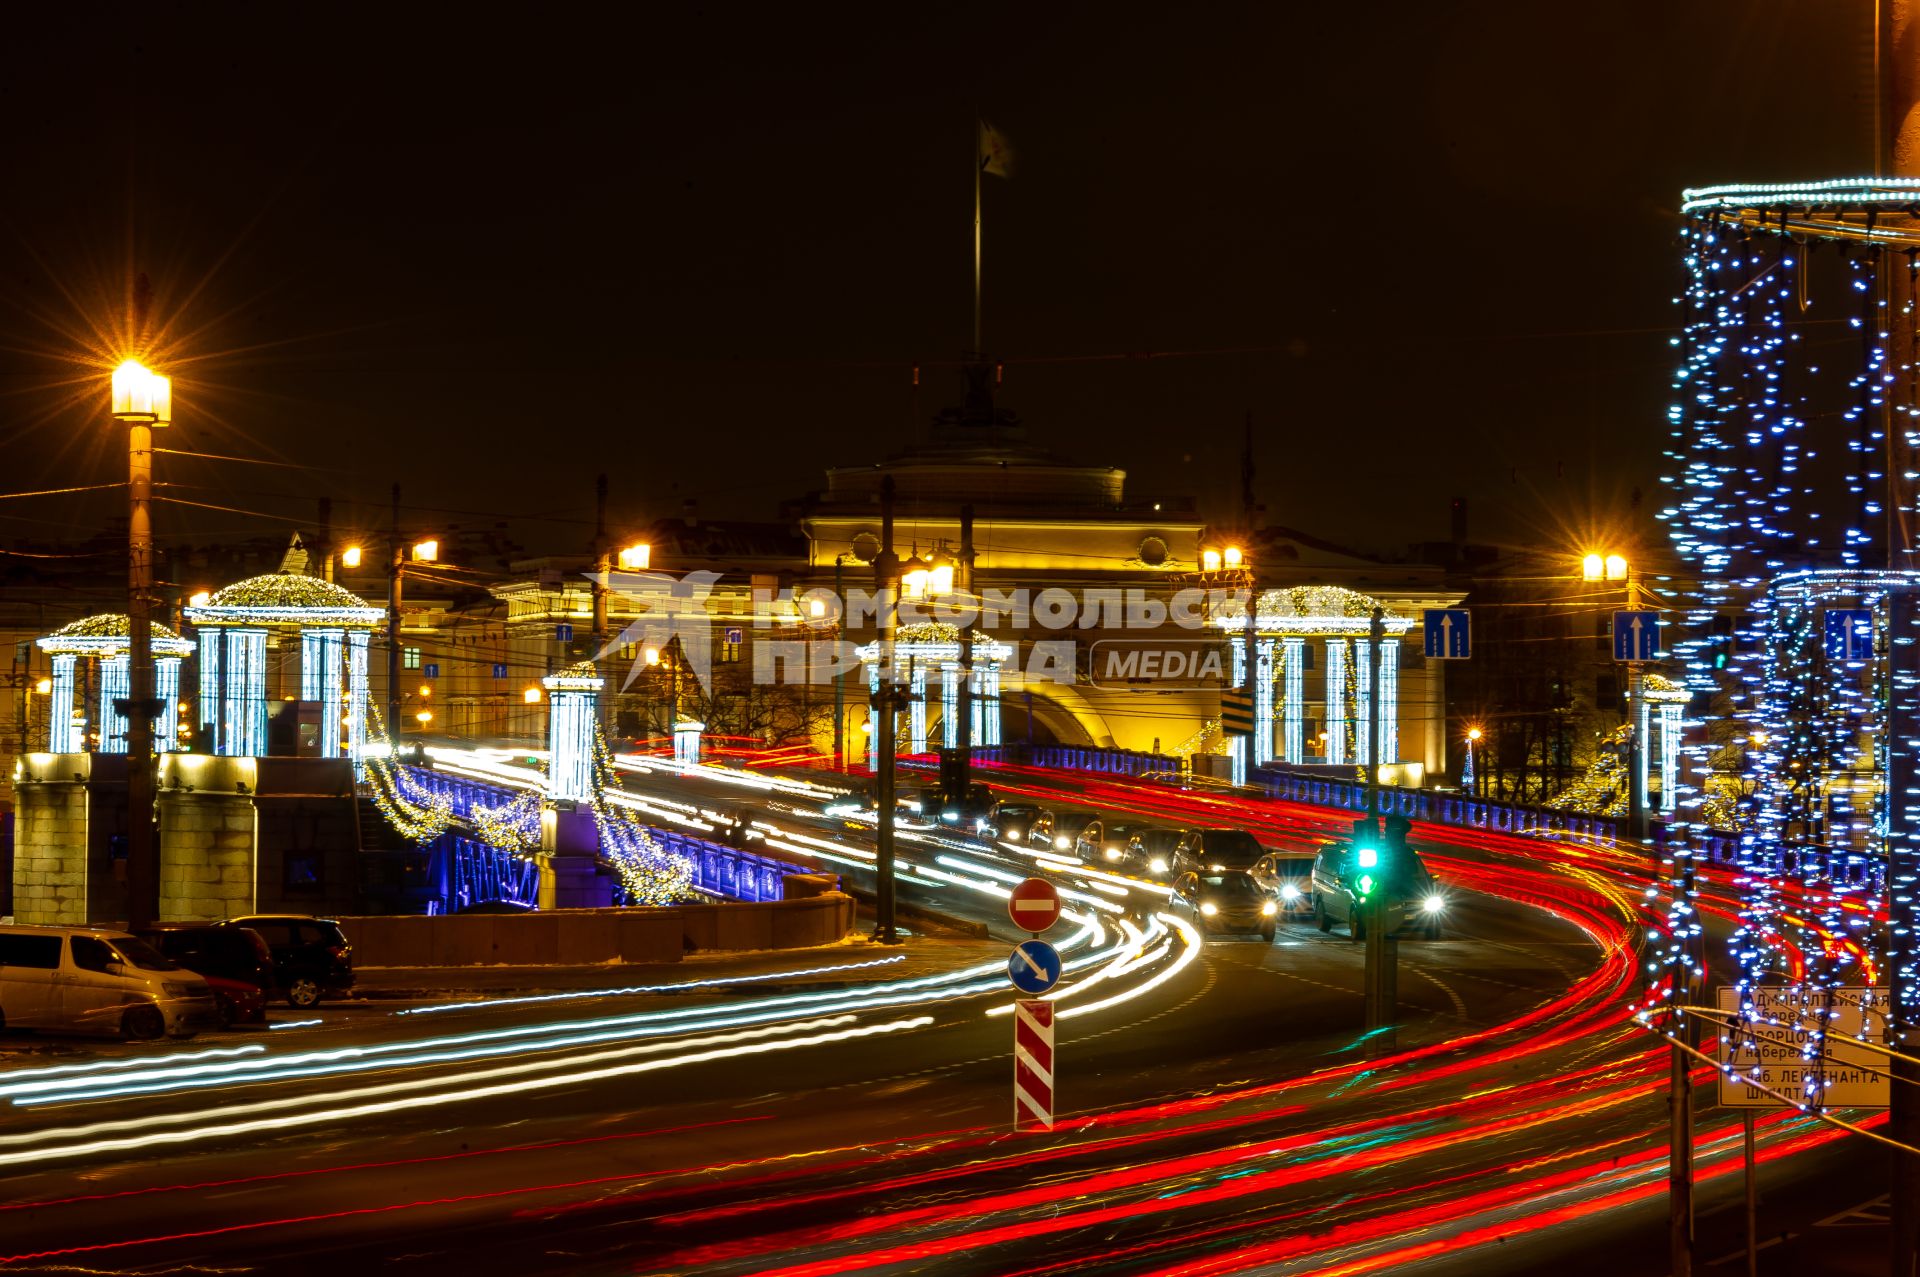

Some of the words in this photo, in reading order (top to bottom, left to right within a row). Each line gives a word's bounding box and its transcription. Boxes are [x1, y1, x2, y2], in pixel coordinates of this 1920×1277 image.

[1744, 991, 1890, 1009] ДМИРЛТЙСАЯ
[1746, 1030, 1837, 1044] ВОРЦОВЯ
[1746, 1044, 1832, 1061] наберея
